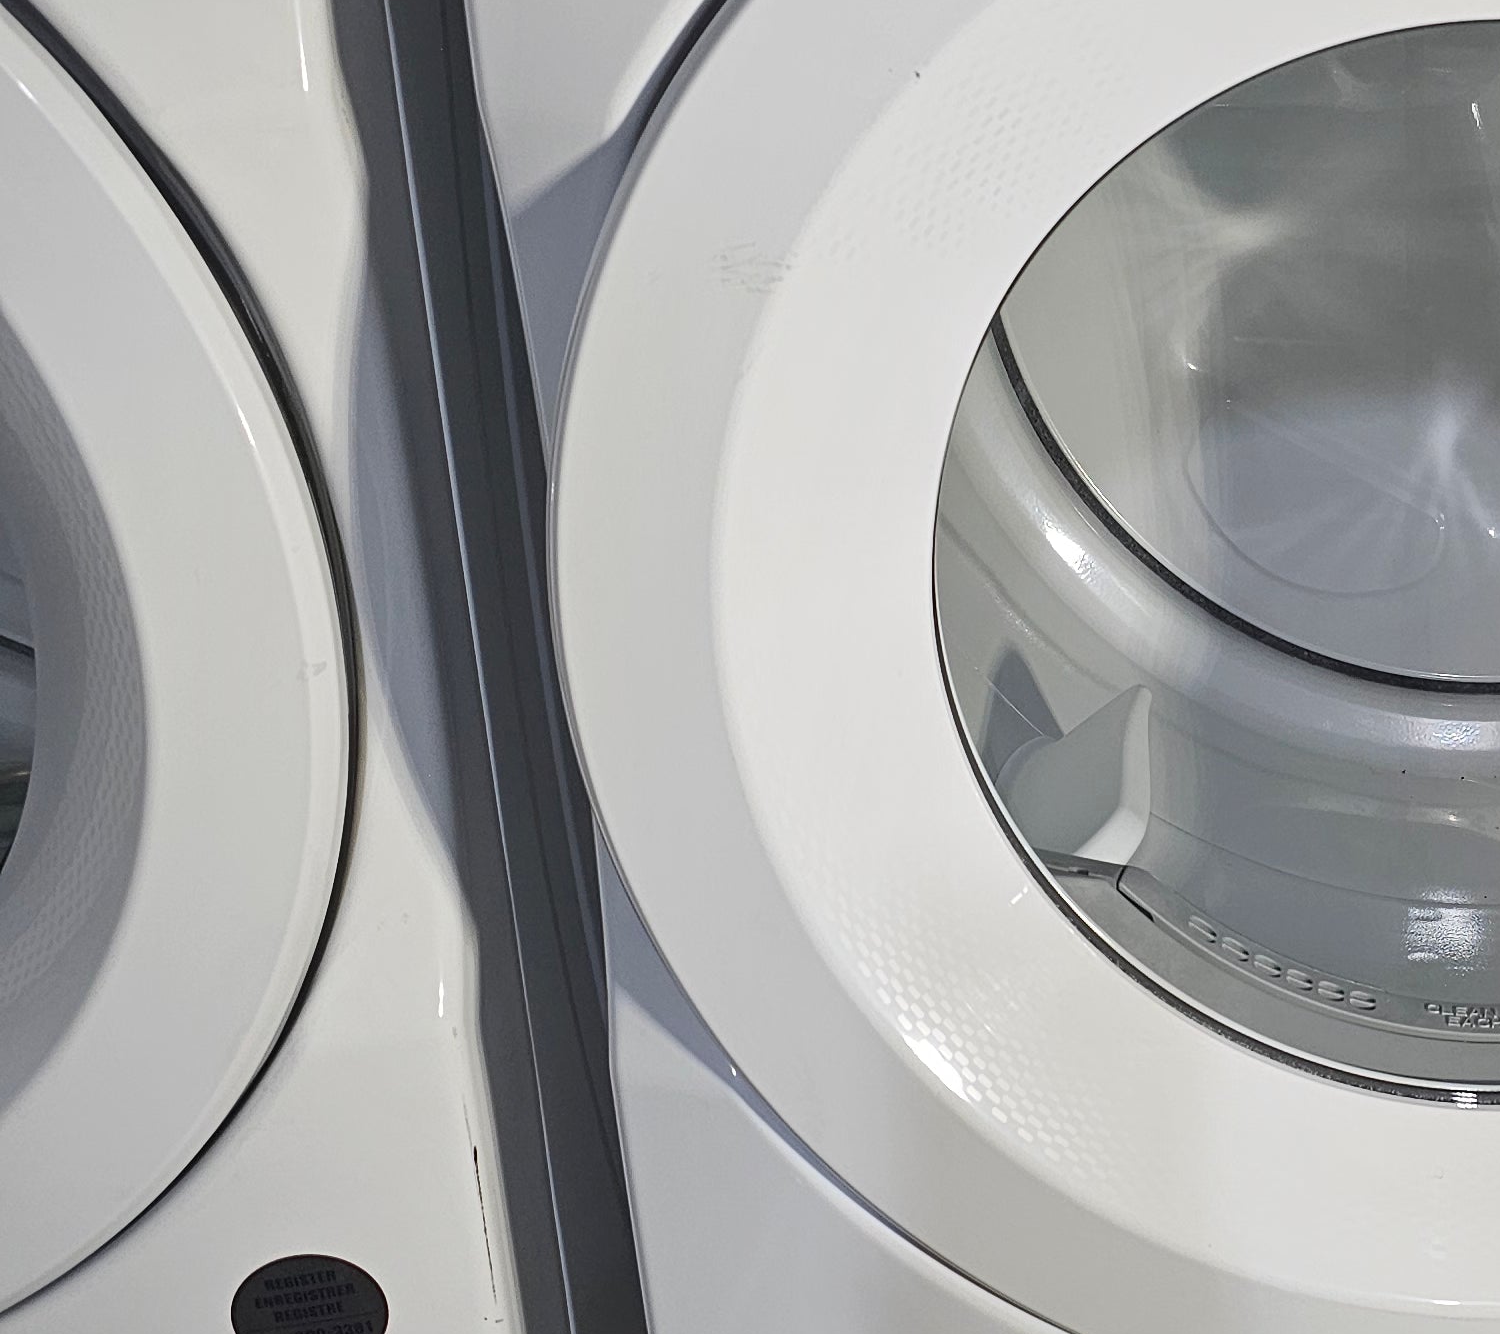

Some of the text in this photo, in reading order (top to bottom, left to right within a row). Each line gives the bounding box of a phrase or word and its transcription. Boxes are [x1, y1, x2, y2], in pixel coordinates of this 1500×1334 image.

[1427, 1002, 1497, 1018] CLEAN
[264, 1269, 338, 1292] REGISTER
[273, 1300, 345, 1323] REGISTRE
